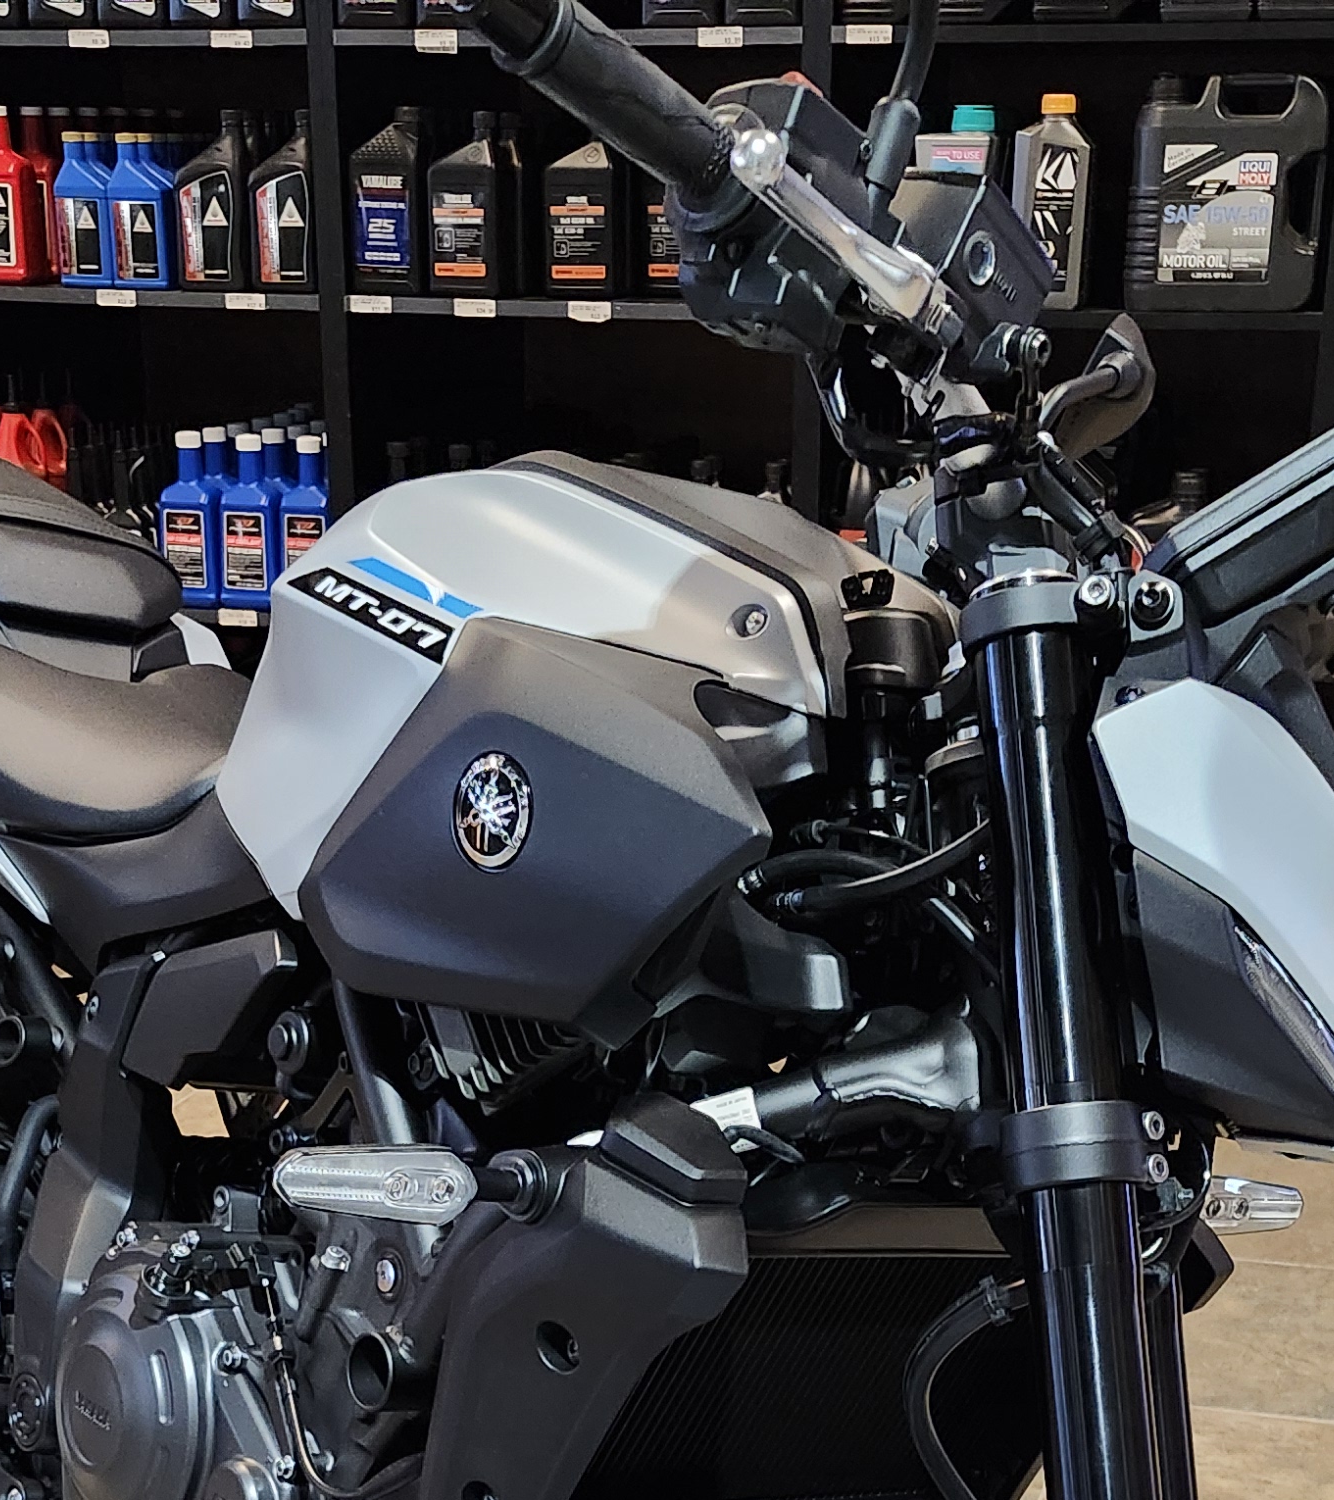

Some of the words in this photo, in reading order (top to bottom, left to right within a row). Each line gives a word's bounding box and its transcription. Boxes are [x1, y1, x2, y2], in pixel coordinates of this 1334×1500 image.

[952, 150, 963, 159] TO
[963, 150, 981, 160] USE
[1240, 161, 1271, 173] LIQUI
[1239, 173, 1271, 185] MOLY
[1163, 204, 1201, 224] SAE
[1207, 206, 1269, 225] 15W-50
[1232, 227, 1266, 237] STREET
[1162, 254, 1207, 268] MOTOR
[1208, 254, 1227, 268] OIL
[314, 575, 447, 649] MT-07
